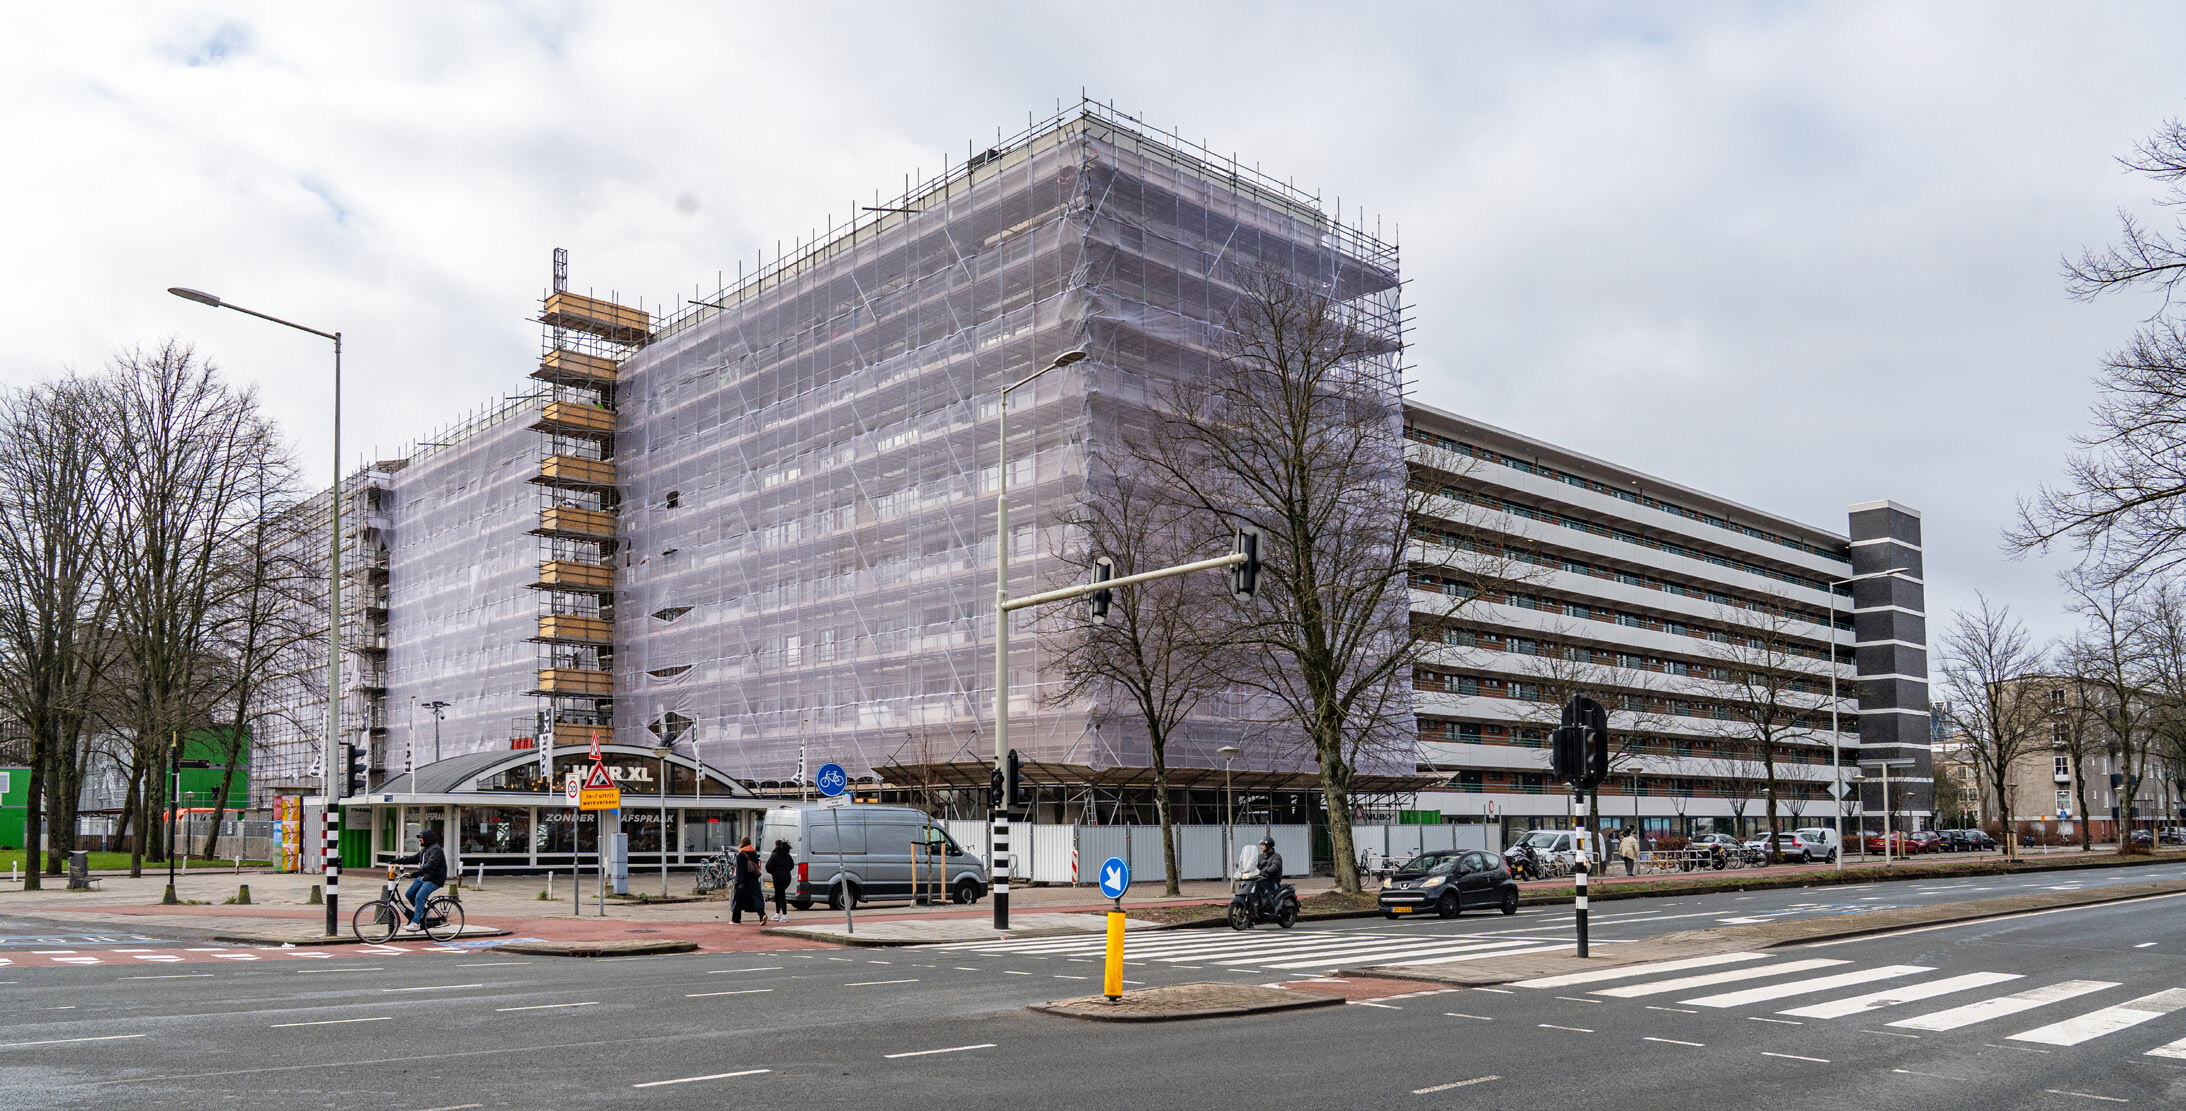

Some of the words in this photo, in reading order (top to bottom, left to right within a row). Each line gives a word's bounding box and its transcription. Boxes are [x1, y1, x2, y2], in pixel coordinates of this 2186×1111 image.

[572, 764, 623, 782] HR
[627, 766, 654, 782] XL
[569, 785, 577, 793] 30
[545, 813, 595, 822] ZONDER
